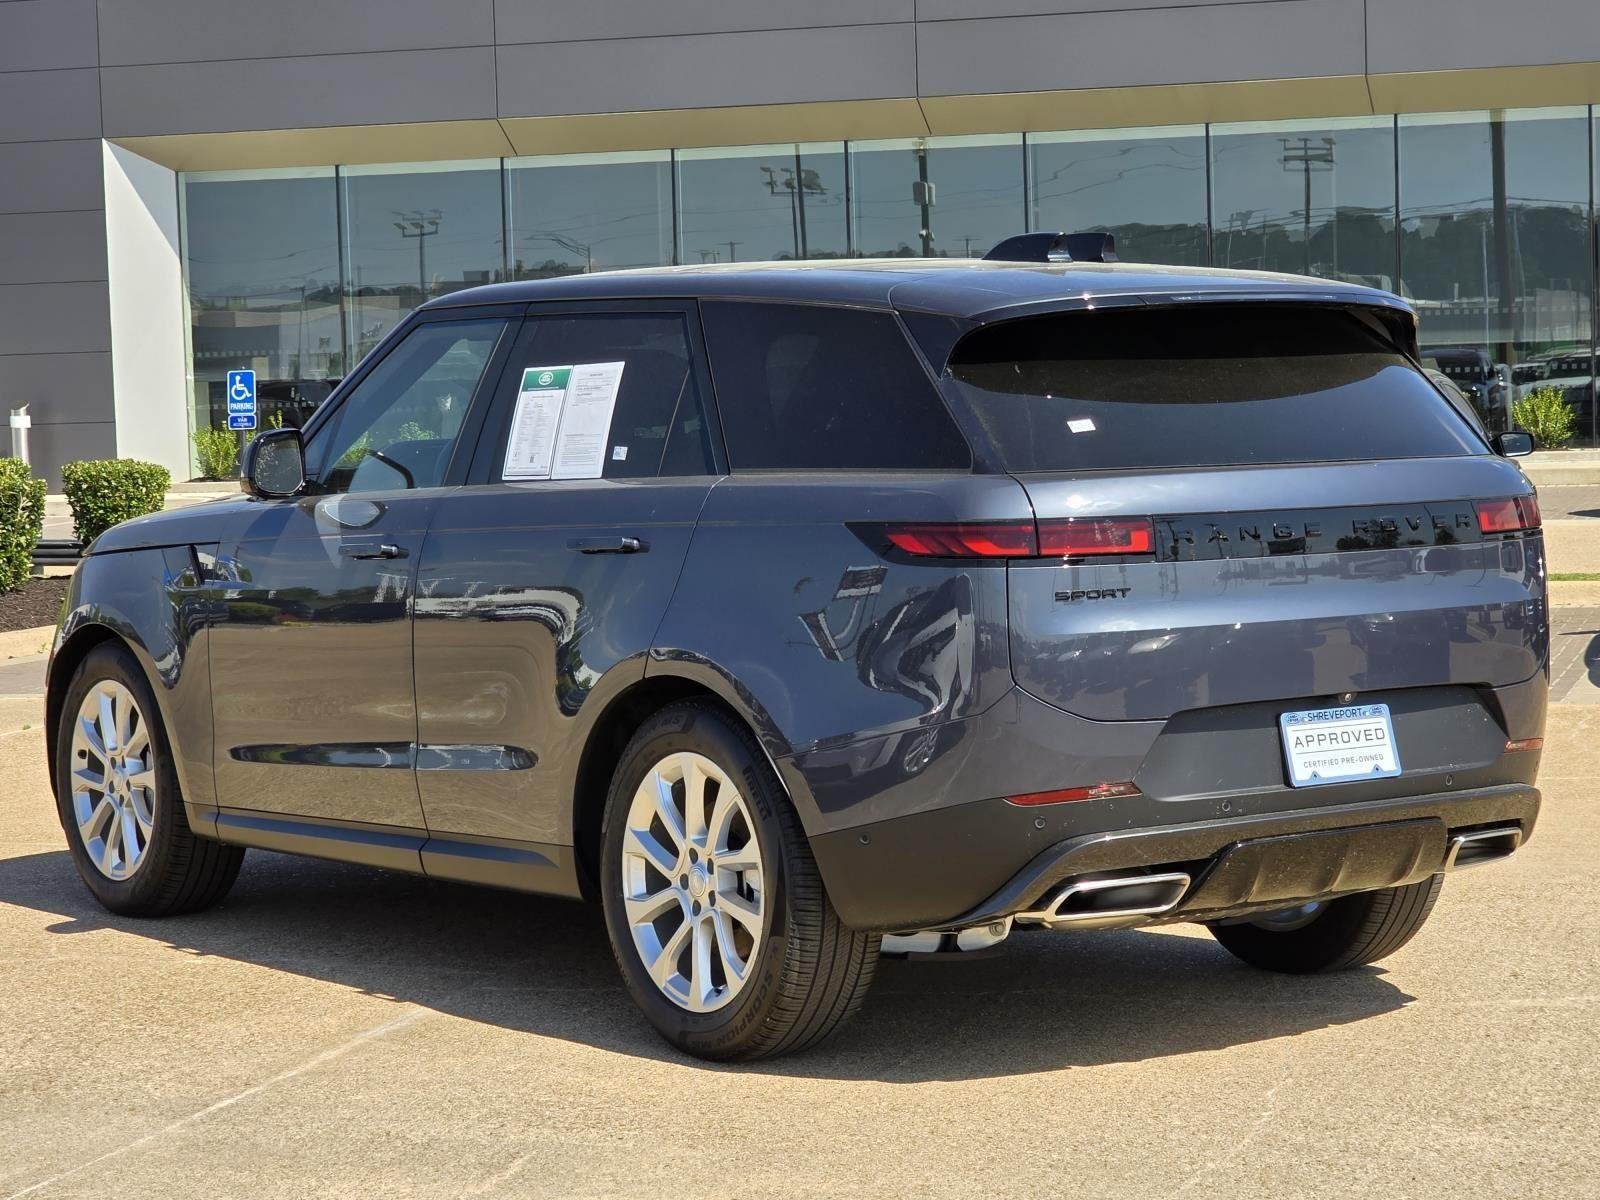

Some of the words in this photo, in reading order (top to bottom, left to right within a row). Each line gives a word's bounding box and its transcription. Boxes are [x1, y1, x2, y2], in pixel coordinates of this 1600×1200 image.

[1173, 522, 1322, 545] RANGE
[1352, 513, 1472, 535] ROVER
[1054, 587, 1132, 602] SPORT
[1307, 708, 1362, 721] SHREVEPORT
[1294, 727, 1385, 749] APPROVED
[1303, 758, 1339, 769] CERTIFIED
[1341, 753, 1384, 765] PRE-OWNED
